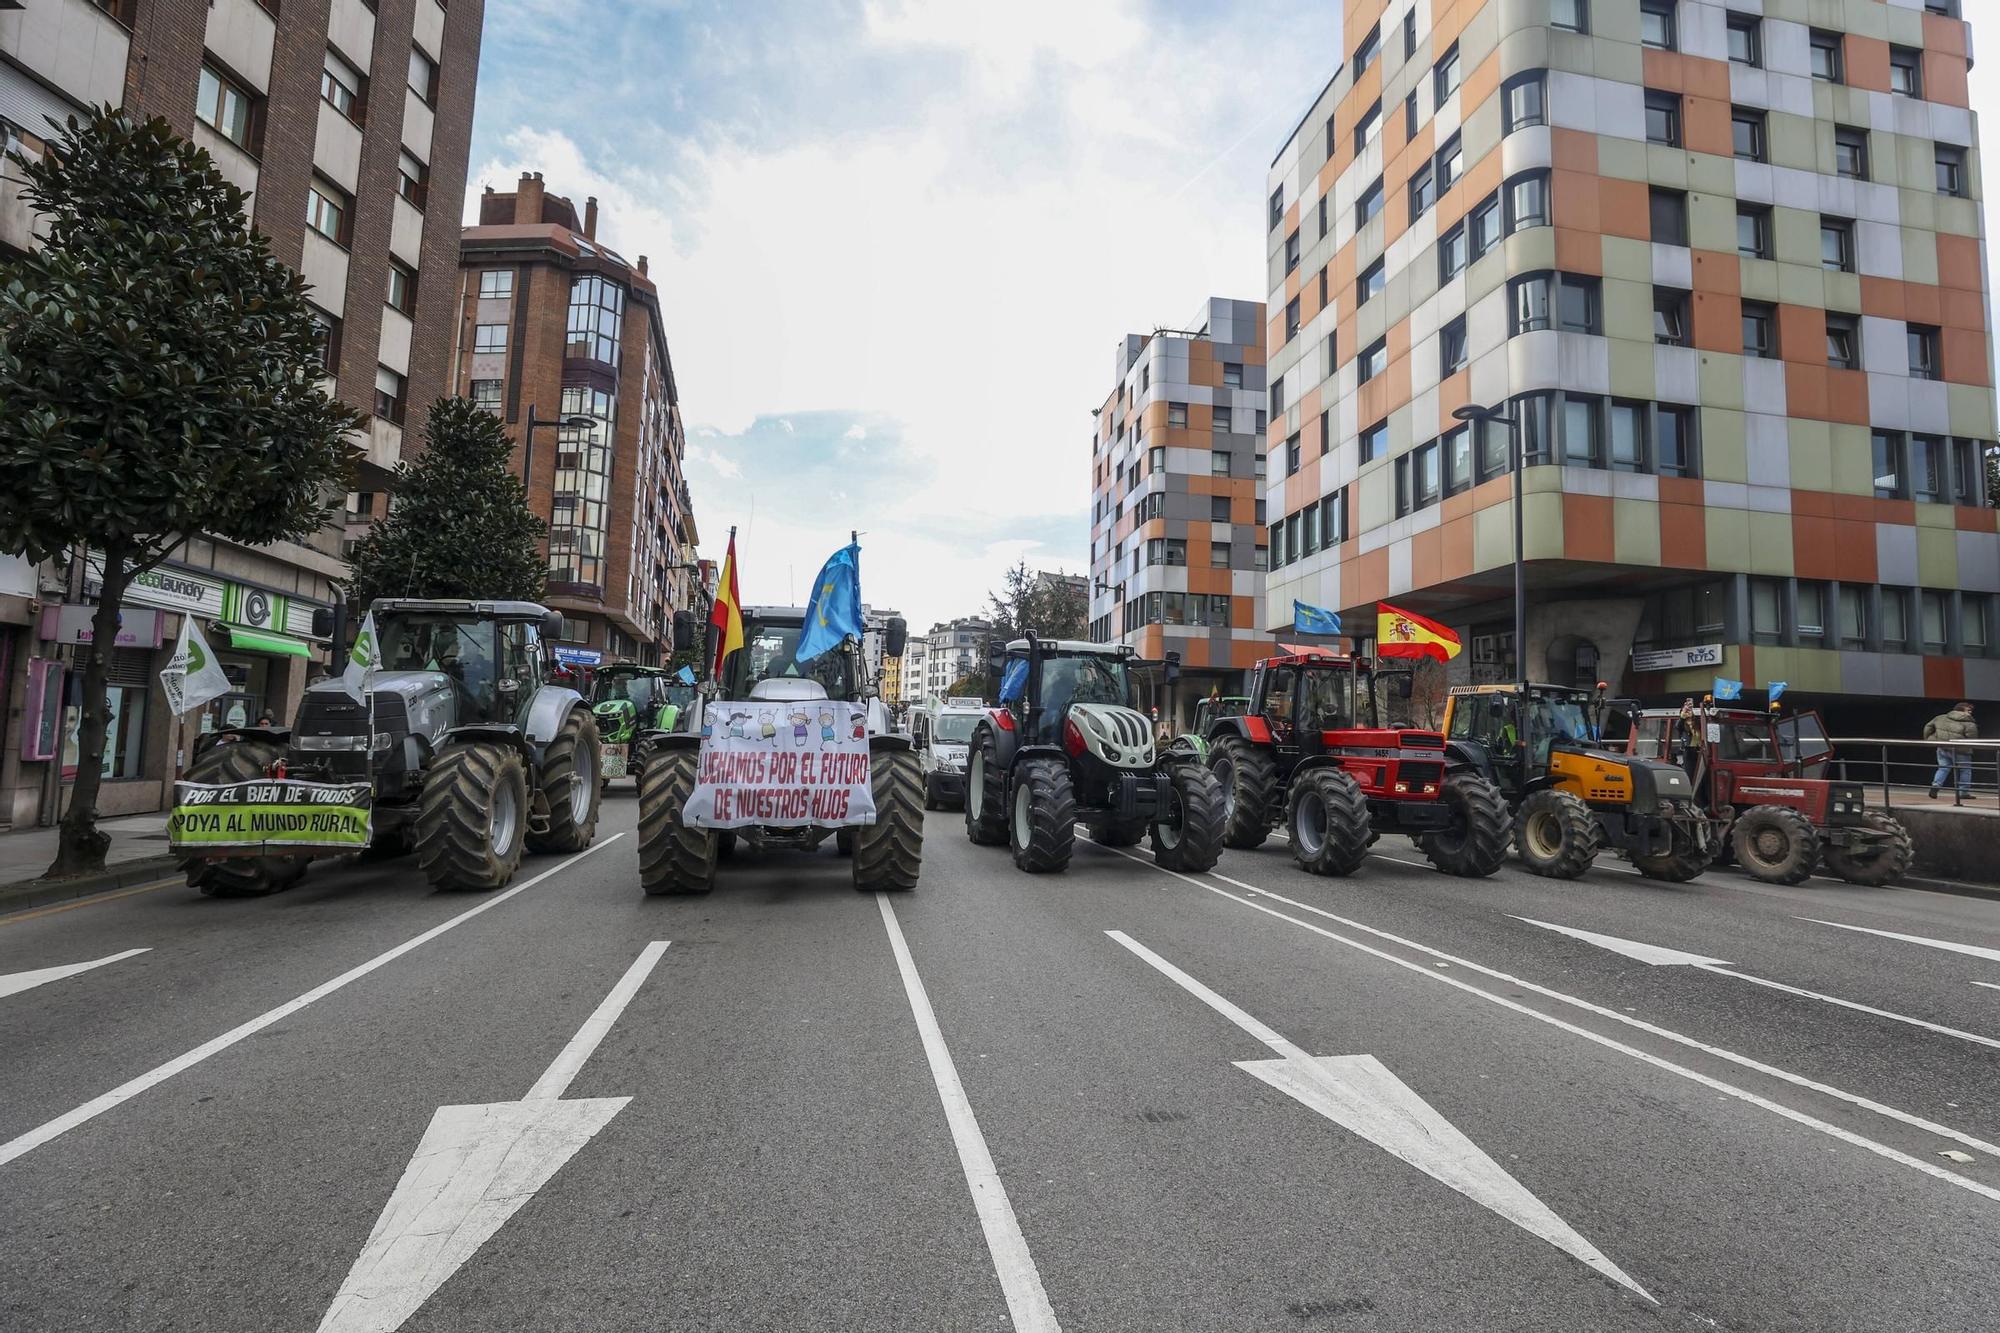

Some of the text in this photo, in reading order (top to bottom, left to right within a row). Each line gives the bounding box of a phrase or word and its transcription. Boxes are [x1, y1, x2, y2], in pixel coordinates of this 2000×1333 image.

[1687, 649, 1716, 664] REYES
[698, 751, 869, 785] LUCHAMOS POR EL FUTURO
[184, 786, 357, 804] POR EL BIEN DE TODOS
[714, 788, 851, 821] DE NUESTROS HIJOS
[226, 813, 247, 832] AL
[251, 813, 308, 832] MUNDO
[310, 813, 361, 834] RURAL
